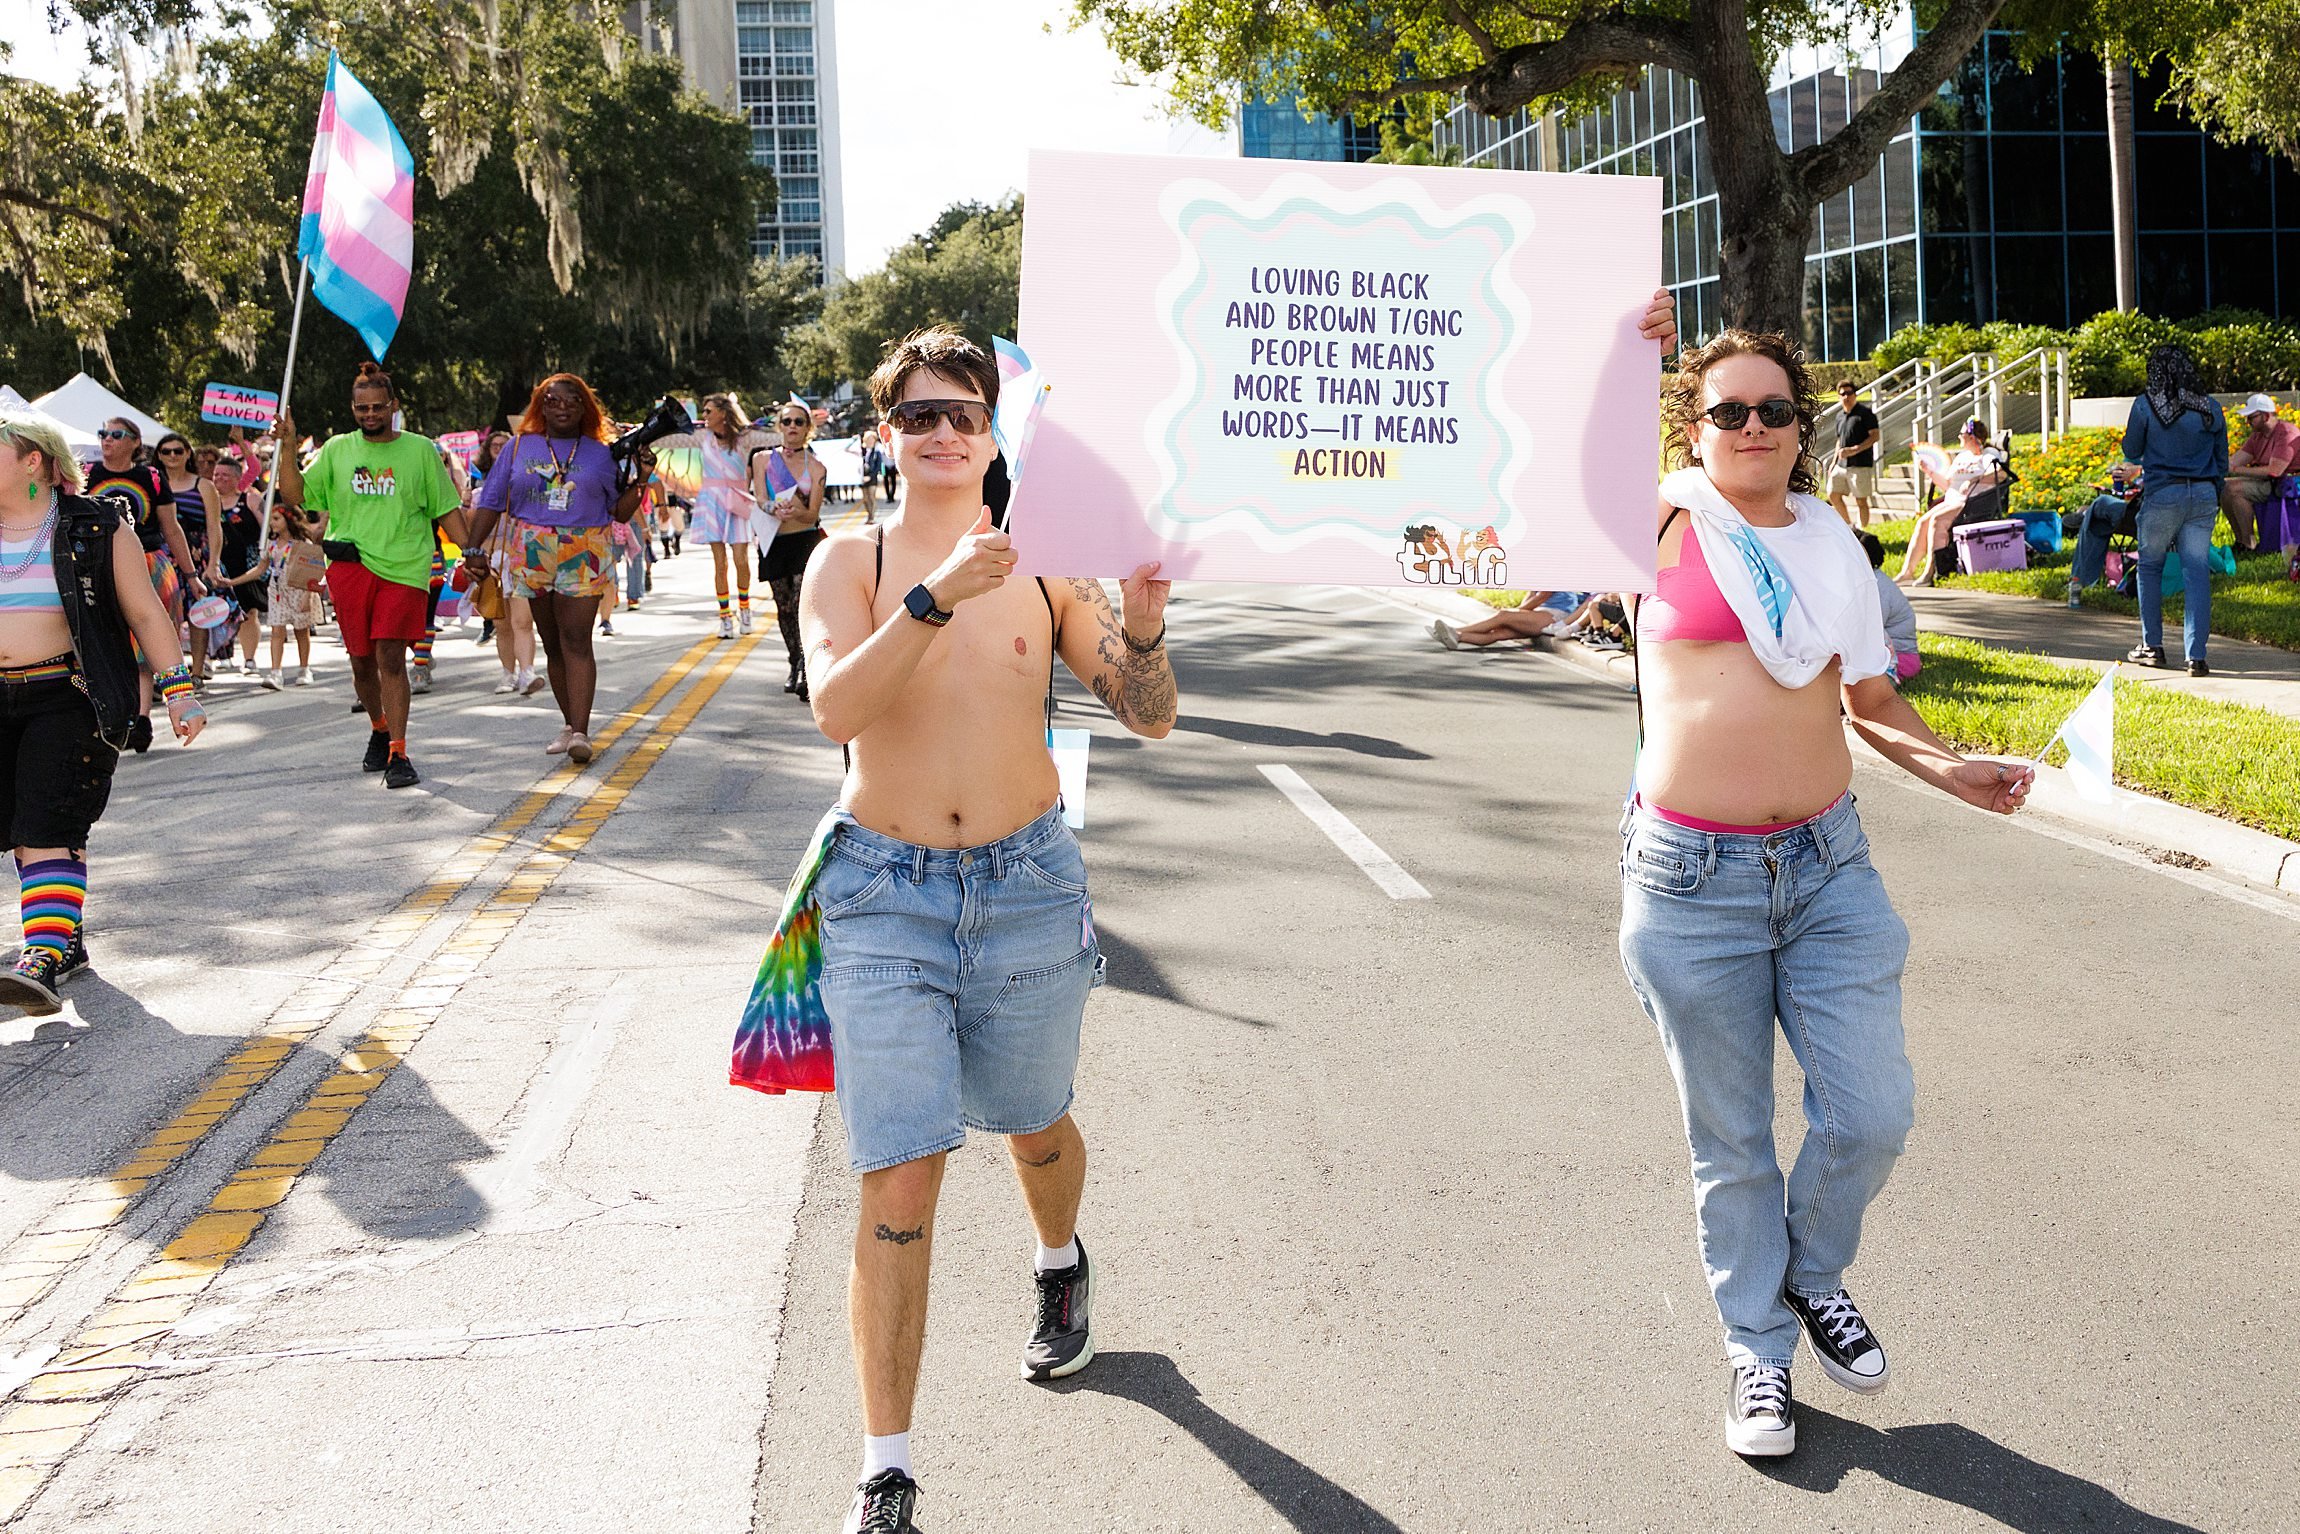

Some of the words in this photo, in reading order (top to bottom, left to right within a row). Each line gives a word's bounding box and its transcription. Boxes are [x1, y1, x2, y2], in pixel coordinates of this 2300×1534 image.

[1251, 266, 1340, 297] LOVING
[1351, 270, 1430, 301] BLACK
[1225, 301, 1275, 330] AND
[1287, 303, 1376, 334] BROWN
[1388, 307, 1463, 337] T/GNC
[1251, 337, 1339, 369] PEOPLE
[1351, 342, 1435, 372] MEANS
[218, 389, 227, 400] I
[234, 391, 258, 405] AM
[1233, 373, 1303, 403] MORE
[1316, 376, 1380, 406] THAN
[1392, 379, 1450, 408] JUST
[212, 404, 265, 422] LOVED
[1375, 415, 1459, 445] MEANS
[1293, 448, 1385, 479] ACTION
